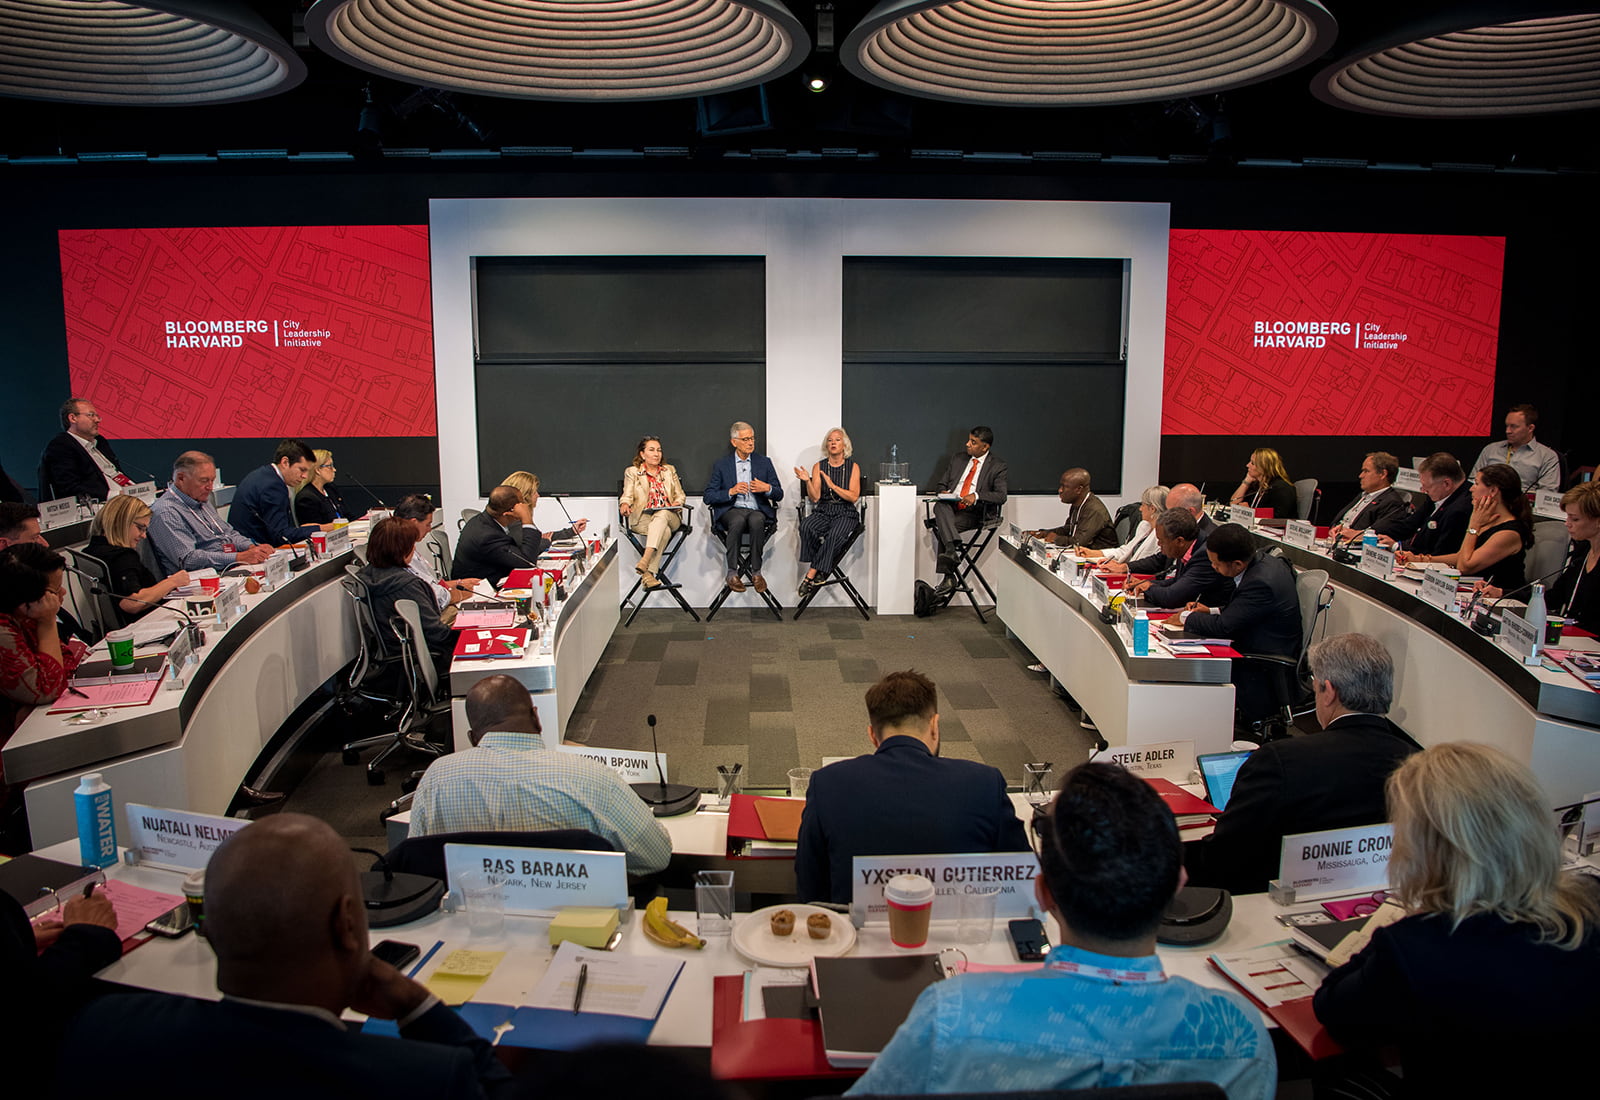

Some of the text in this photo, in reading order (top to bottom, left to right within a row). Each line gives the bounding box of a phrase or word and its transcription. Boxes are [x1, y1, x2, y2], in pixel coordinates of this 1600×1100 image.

[165, 320, 268, 334] BLOOMBERG
[282, 320, 300, 330] City
[1254, 321, 1351, 335] BLOOMBERG
[1364, 323, 1380, 332] City
[283, 329, 331, 339] Leadership
[1364, 332, 1408, 342] Leadership
[166, 335, 243, 348] HARVARD
[284, 338, 322, 347] Initiative
[1253, 335, 1326, 348] HARVARD
[1363, 341, 1398, 349] Initiative
[611, 757, 648, 769] BROWN
[1112, 749, 1175, 765] STEVE ADLER
[96, 802, 114, 858] WATER
[142, 816, 237, 841] NUATALI NELM
[1302, 840, 1353, 860] BONNIE
[482, 858, 589, 878] RAS BARAKA
[1317, 858, 1369, 870] MISSISSAUGA,
[943, 865, 1036, 882] GUTIERREZ
[531, 878, 553, 888] NEW
[556, 880, 587, 891] JERSEY
